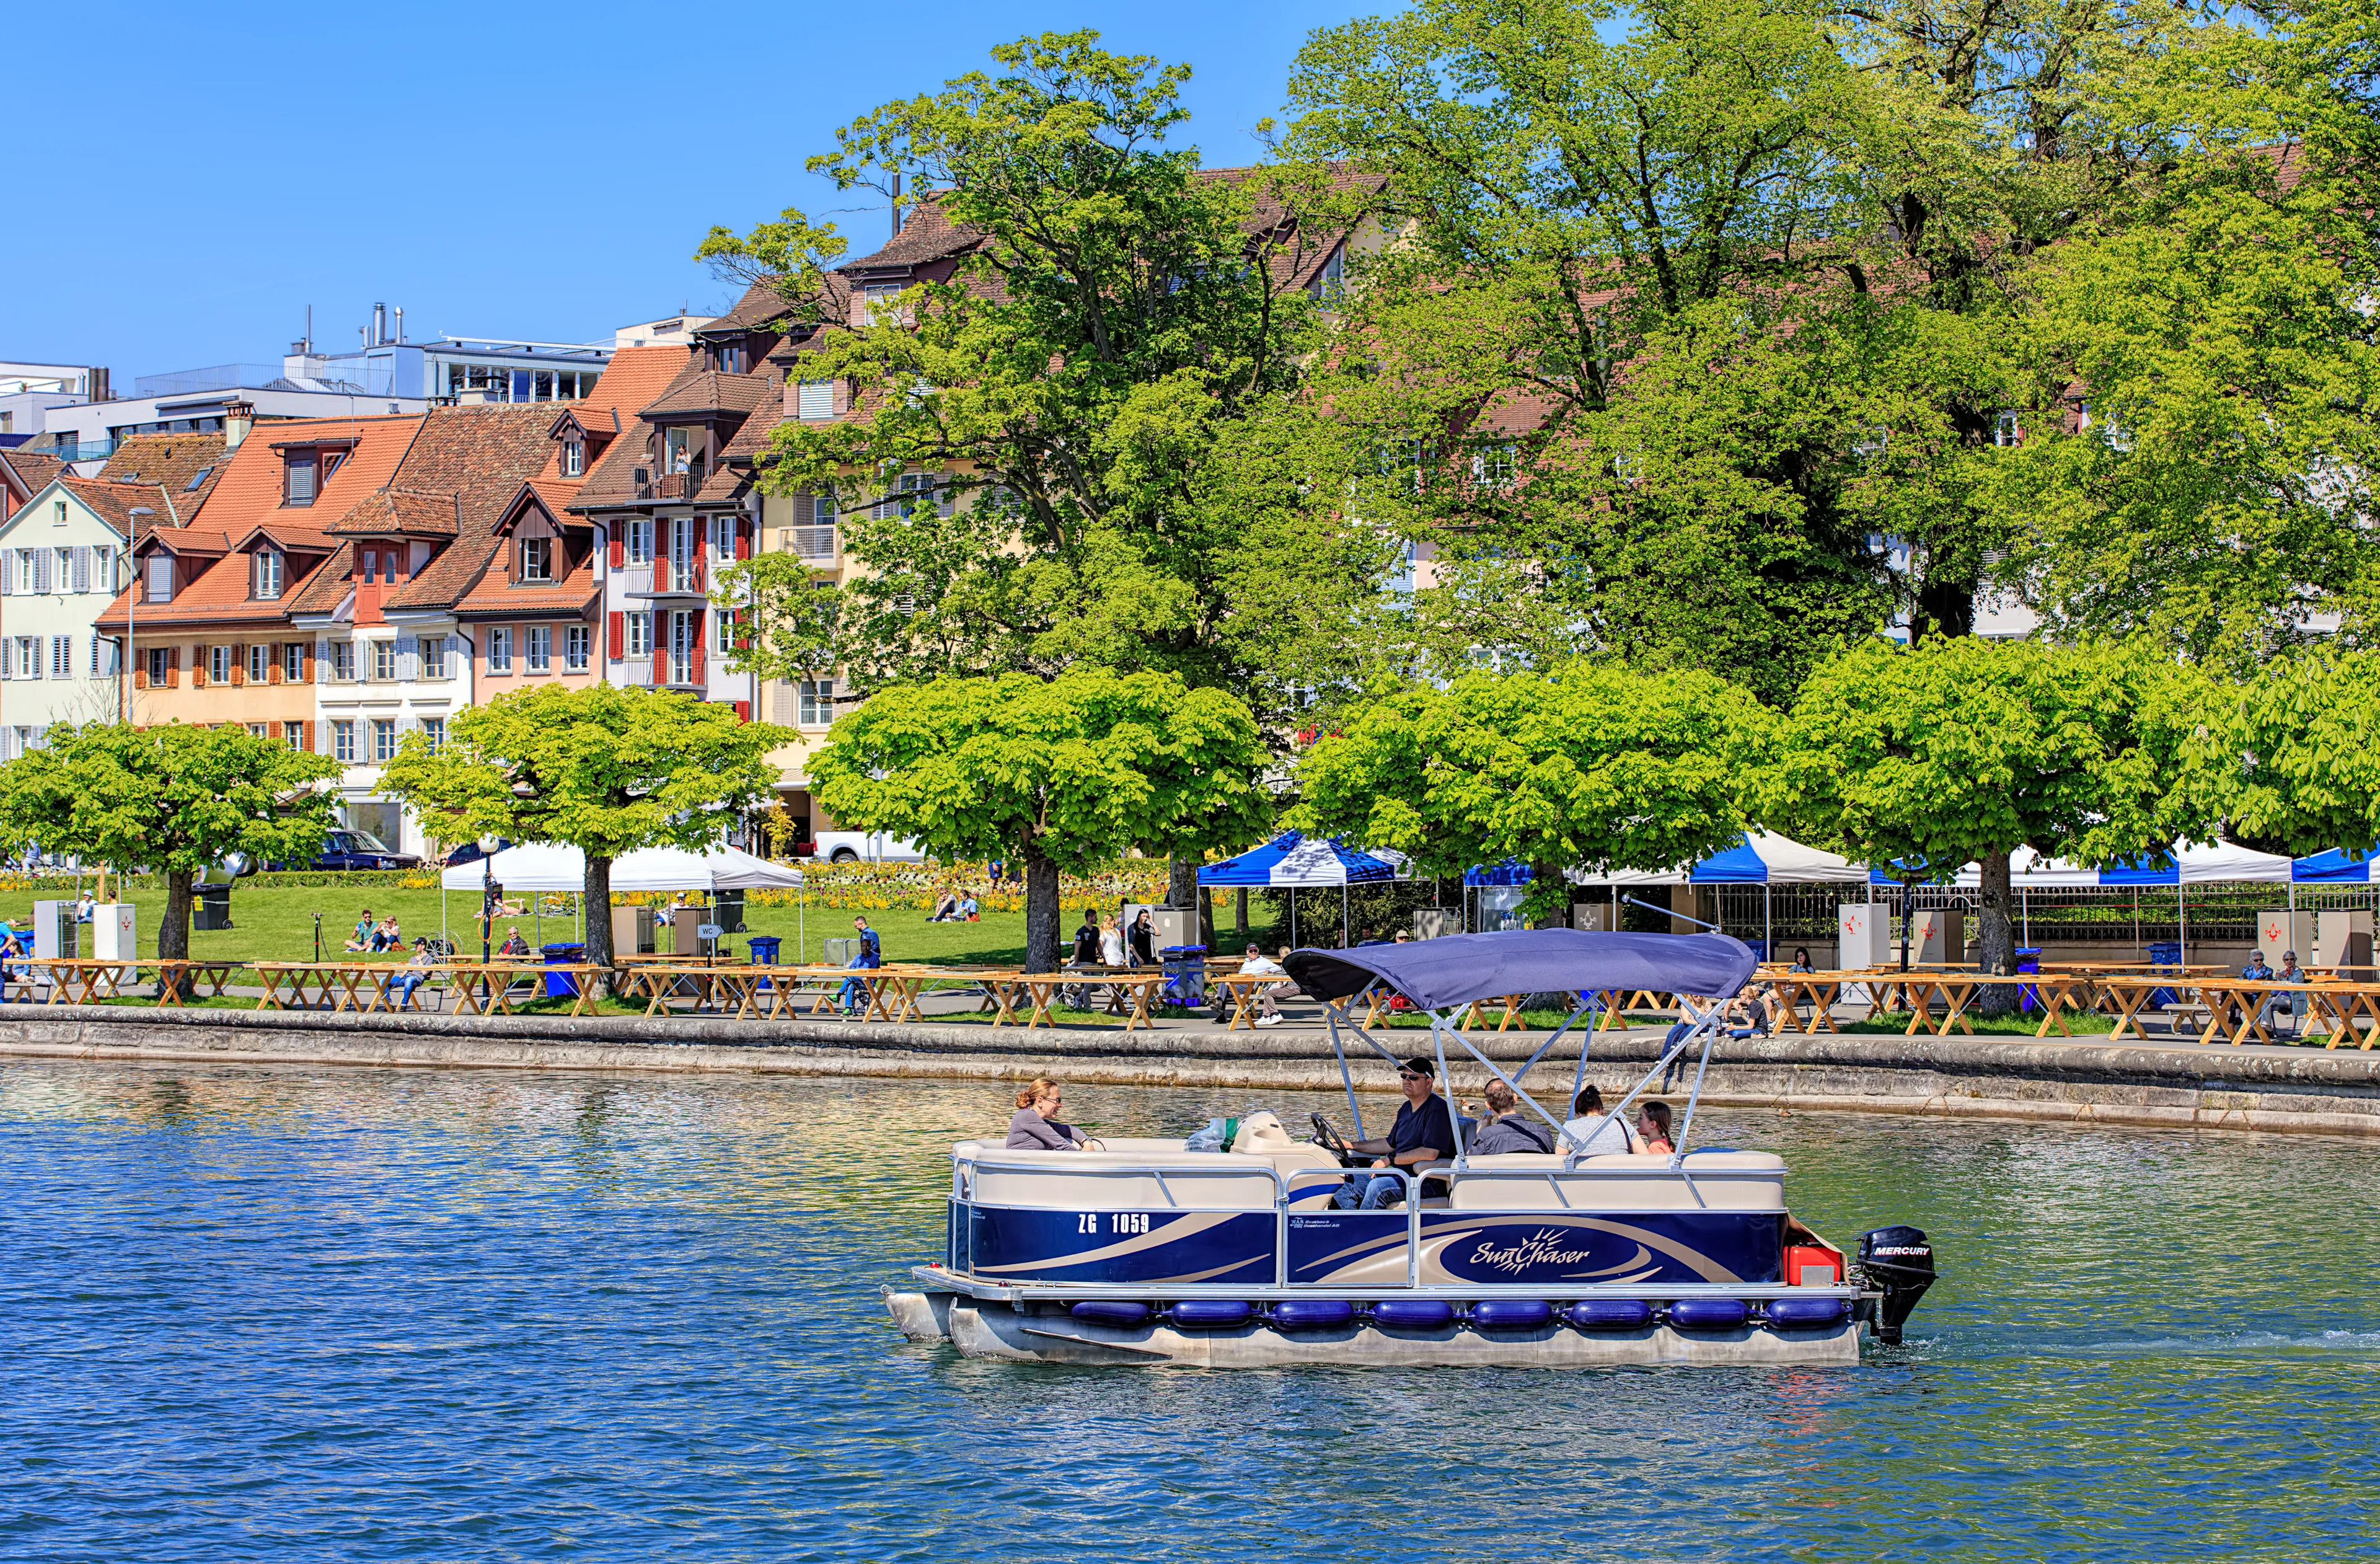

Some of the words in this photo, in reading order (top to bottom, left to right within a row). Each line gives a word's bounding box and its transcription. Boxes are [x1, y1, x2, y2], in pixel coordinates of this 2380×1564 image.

[1078, 1214, 1096, 1233] ZG
[1112, 1213, 1149, 1233] 1059
[1470, 1241, 1590, 1264] SunChaser
[1874, 1247, 1929, 1256] MERCURY
